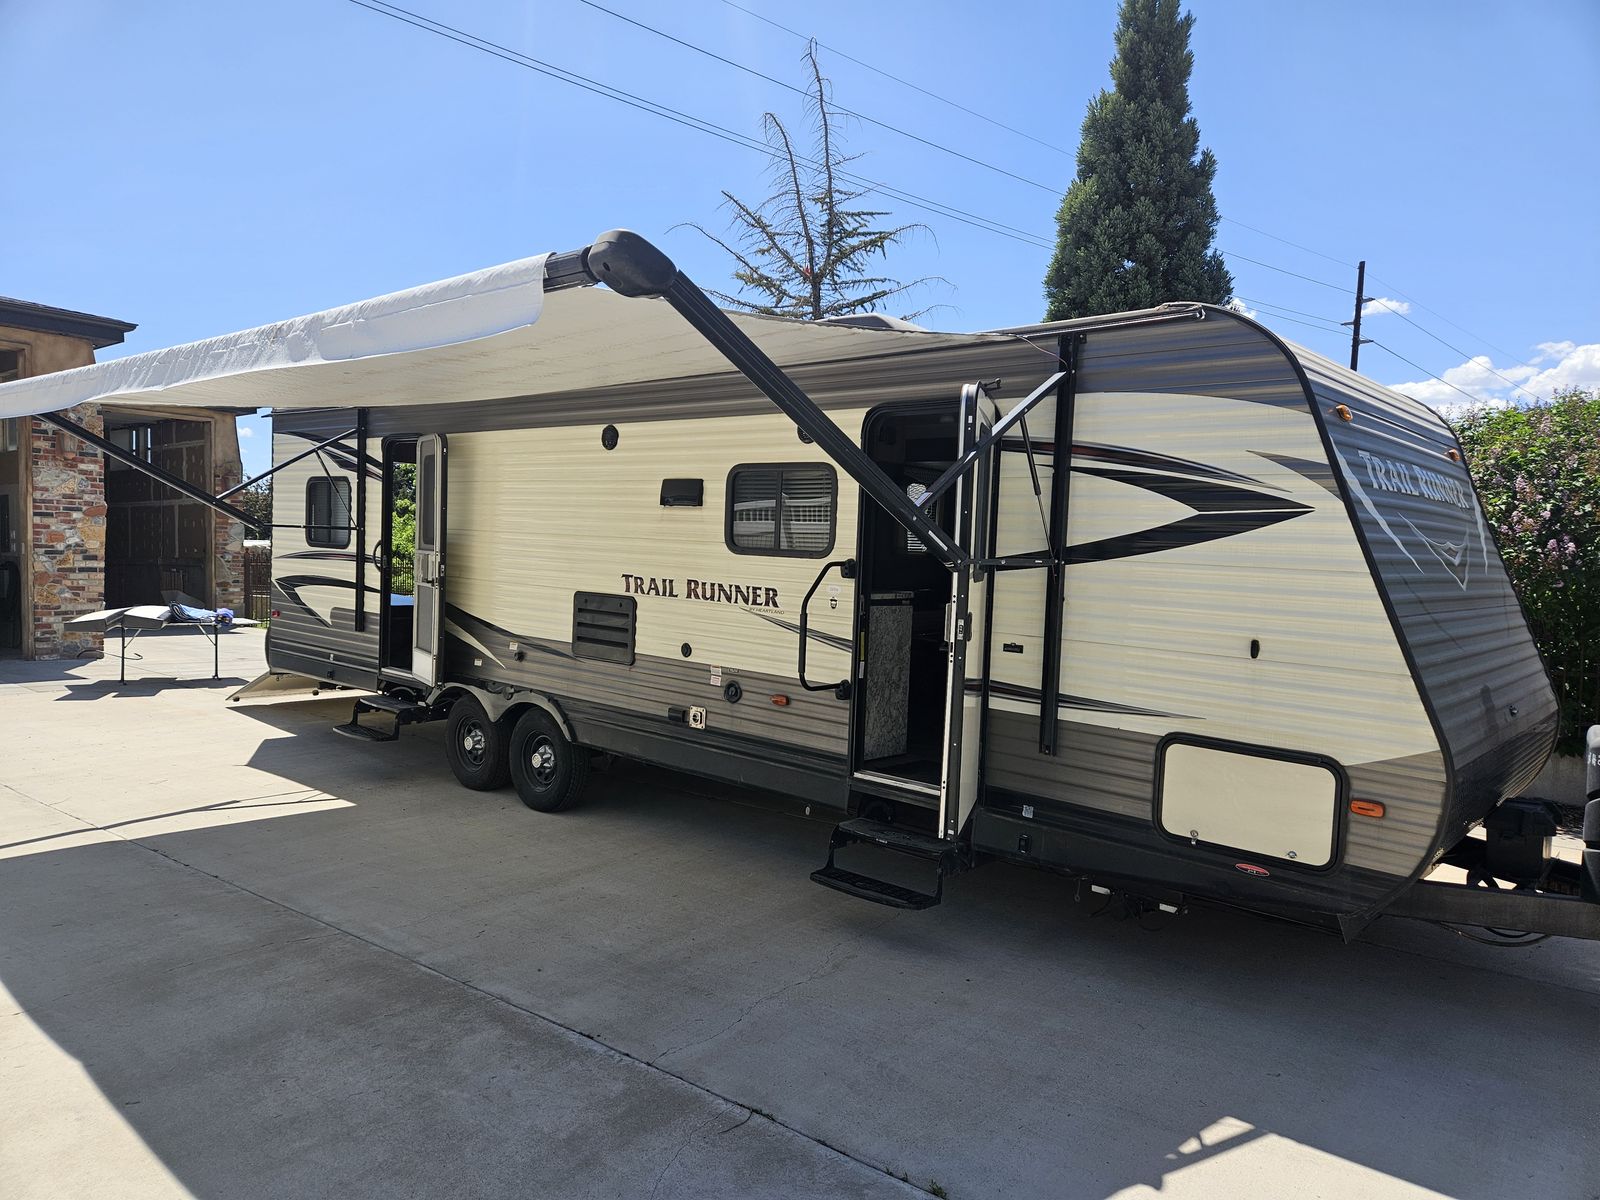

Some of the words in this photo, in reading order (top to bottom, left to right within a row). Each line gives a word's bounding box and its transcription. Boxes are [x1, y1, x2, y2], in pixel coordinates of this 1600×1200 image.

[1358, 450, 1420, 495] TRAIL
[1412, 464, 1470, 509] RUNNER
[622, 574, 678, 597] TRAIL
[686, 579, 779, 608] RUNNER
